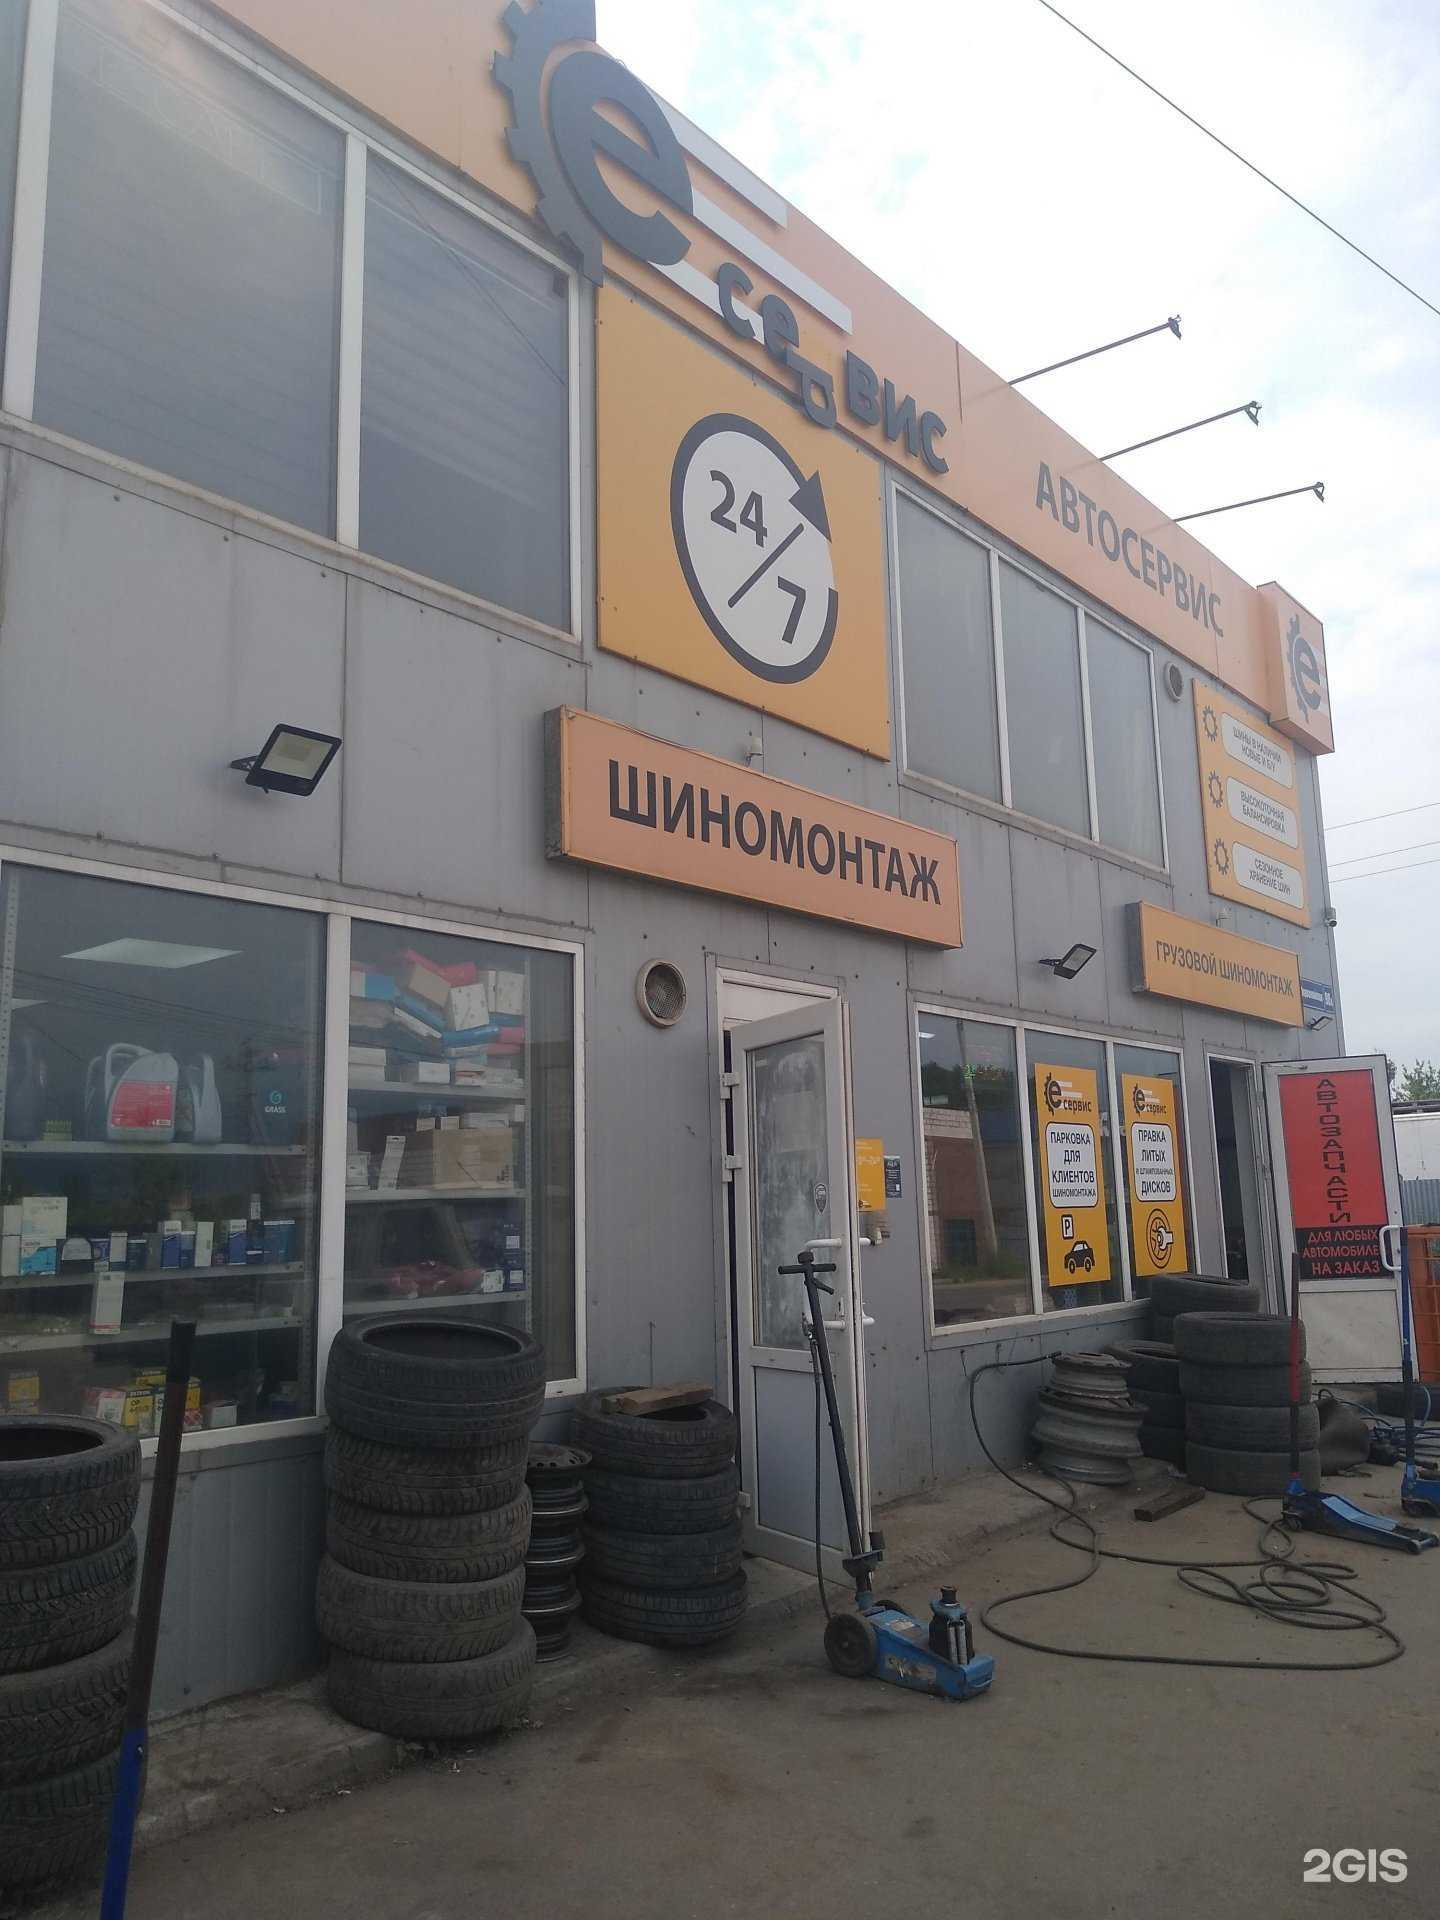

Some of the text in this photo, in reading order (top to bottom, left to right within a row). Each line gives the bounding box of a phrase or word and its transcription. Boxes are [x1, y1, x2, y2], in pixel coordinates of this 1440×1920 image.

[1036, 461, 1224, 637] АВТОСЕРВИС
[1240, 790, 1285, 823] ВЫСОКОТОЧНАЯ
[1242, 804, 1287, 833] БАЛАНСИРОВКА
[609, 759, 941, 905] ШИНОМОНТАЖ
[1255, 858, 1284, 880] СЕЗОННОЕ
[1249, 869, 1278, 890] ХРАНЕНИЕ
[1156, 940, 1294, 998] ГРУЗОВОЙ ШИНОМОНТАЖ
[1063, 1099, 1092, 1114] сервис
[1146, 1103, 1167, 1115] сервис
[1050, 1131, 1091, 1145] ПАРКОВКА
[1138, 1130, 1166, 1142] ПРАВКА
[1063, 1150, 1081, 1164] ДЛЯ
[1142, 1149, 1166, 1162] ЛИТЫХ
[1052, 1170, 1095, 1184] КЛИЕНТОВ
[1052, 1187, 1097, 1199] ШИНОМОНТАЖА
[1141, 1180, 1171, 1196] ДИСКОВ
[1308, 1229, 1378, 1245] ДЛЯ ЛЮБЫХ
[1302, 1245, 1380, 1258] АВТОМОБИЛЕ
[1312, 1260, 1380, 1276] НА ЗАКАЗ
